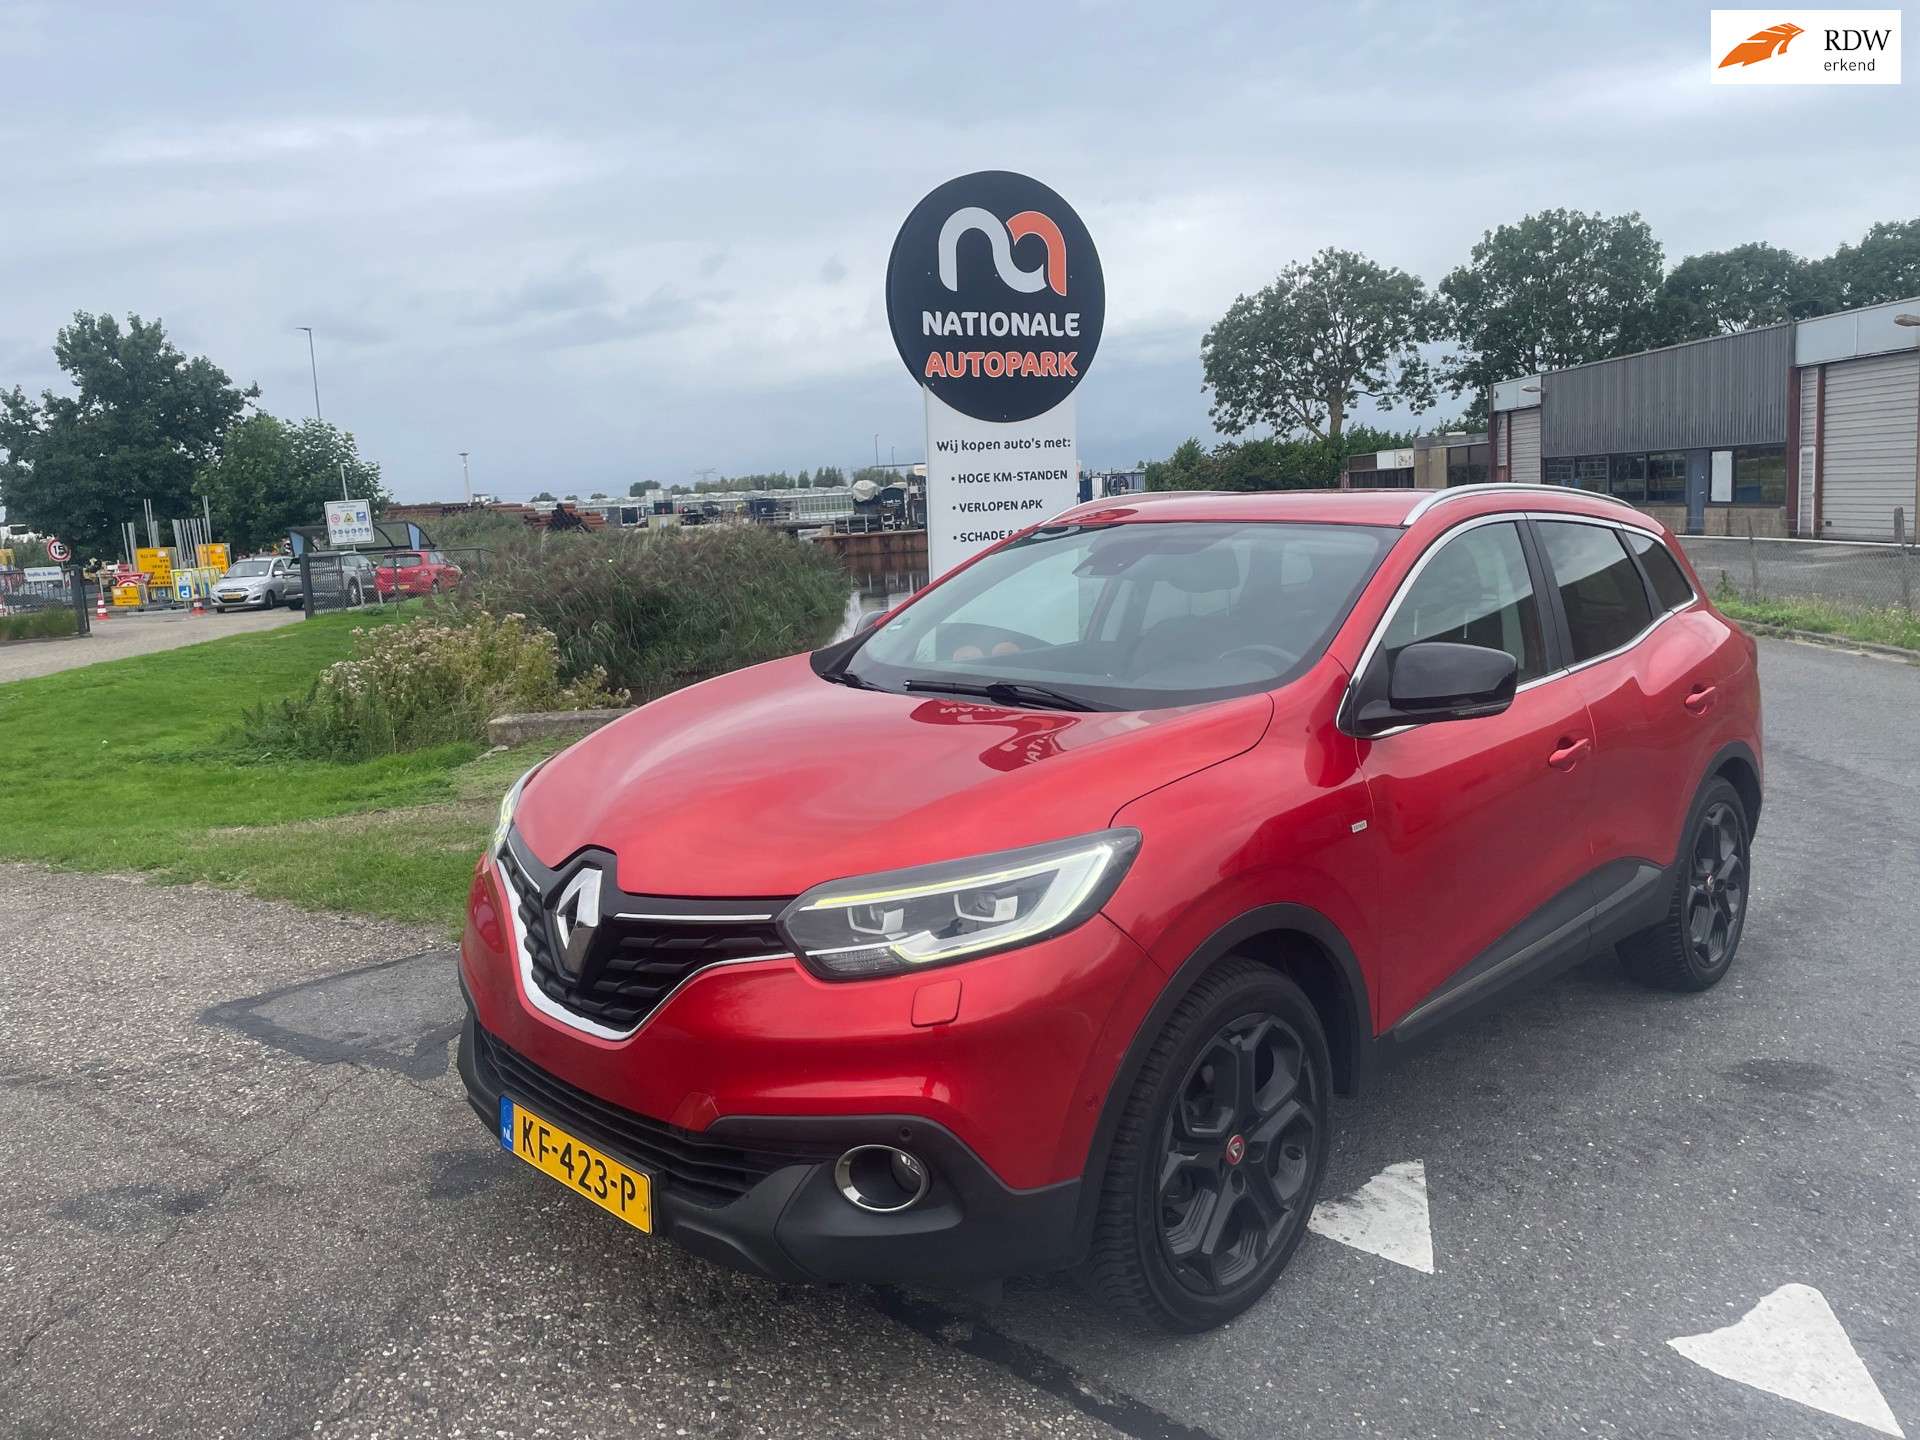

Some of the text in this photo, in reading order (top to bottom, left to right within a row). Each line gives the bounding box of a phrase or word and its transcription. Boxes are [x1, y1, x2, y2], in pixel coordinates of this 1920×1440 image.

[921, 310, 1081, 337] NATIONALE
[924, 350, 1079, 378] AUTOPARK
[936, 437, 1071, 454] Wij kopen auto's met:
[957, 469, 1069, 485] HOGE KM-STANDEN
[959, 499, 1043, 514] VERLOPEN APK
[960, 530, 1005, 543] SCHADE
[53, 544, 66, 556] 15
[503, 1124, 513, 1143] NL
[521, 1115, 637, 1214] KF-423-P
